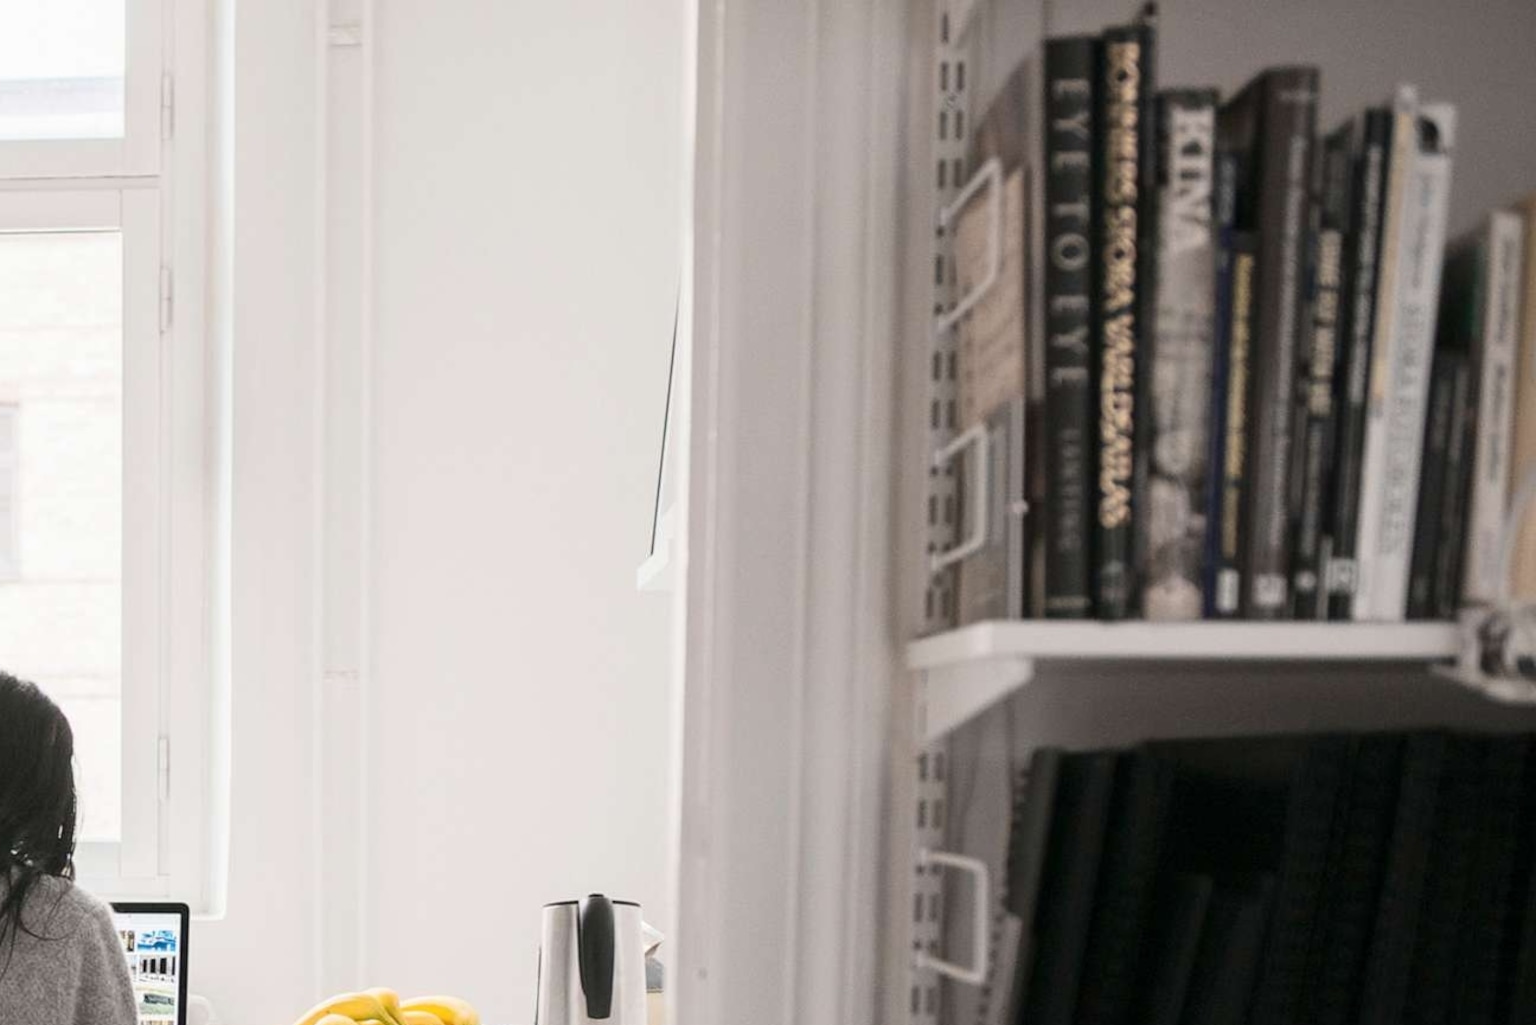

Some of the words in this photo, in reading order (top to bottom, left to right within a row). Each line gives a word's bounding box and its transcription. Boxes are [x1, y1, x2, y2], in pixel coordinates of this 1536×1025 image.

[1052, 79, 1090, 170] EYE
[1164, 106, 1214, 250] KINA
[1052, 200, 1090, 271] TO
[1050, 294, 1089, 386] EYE
